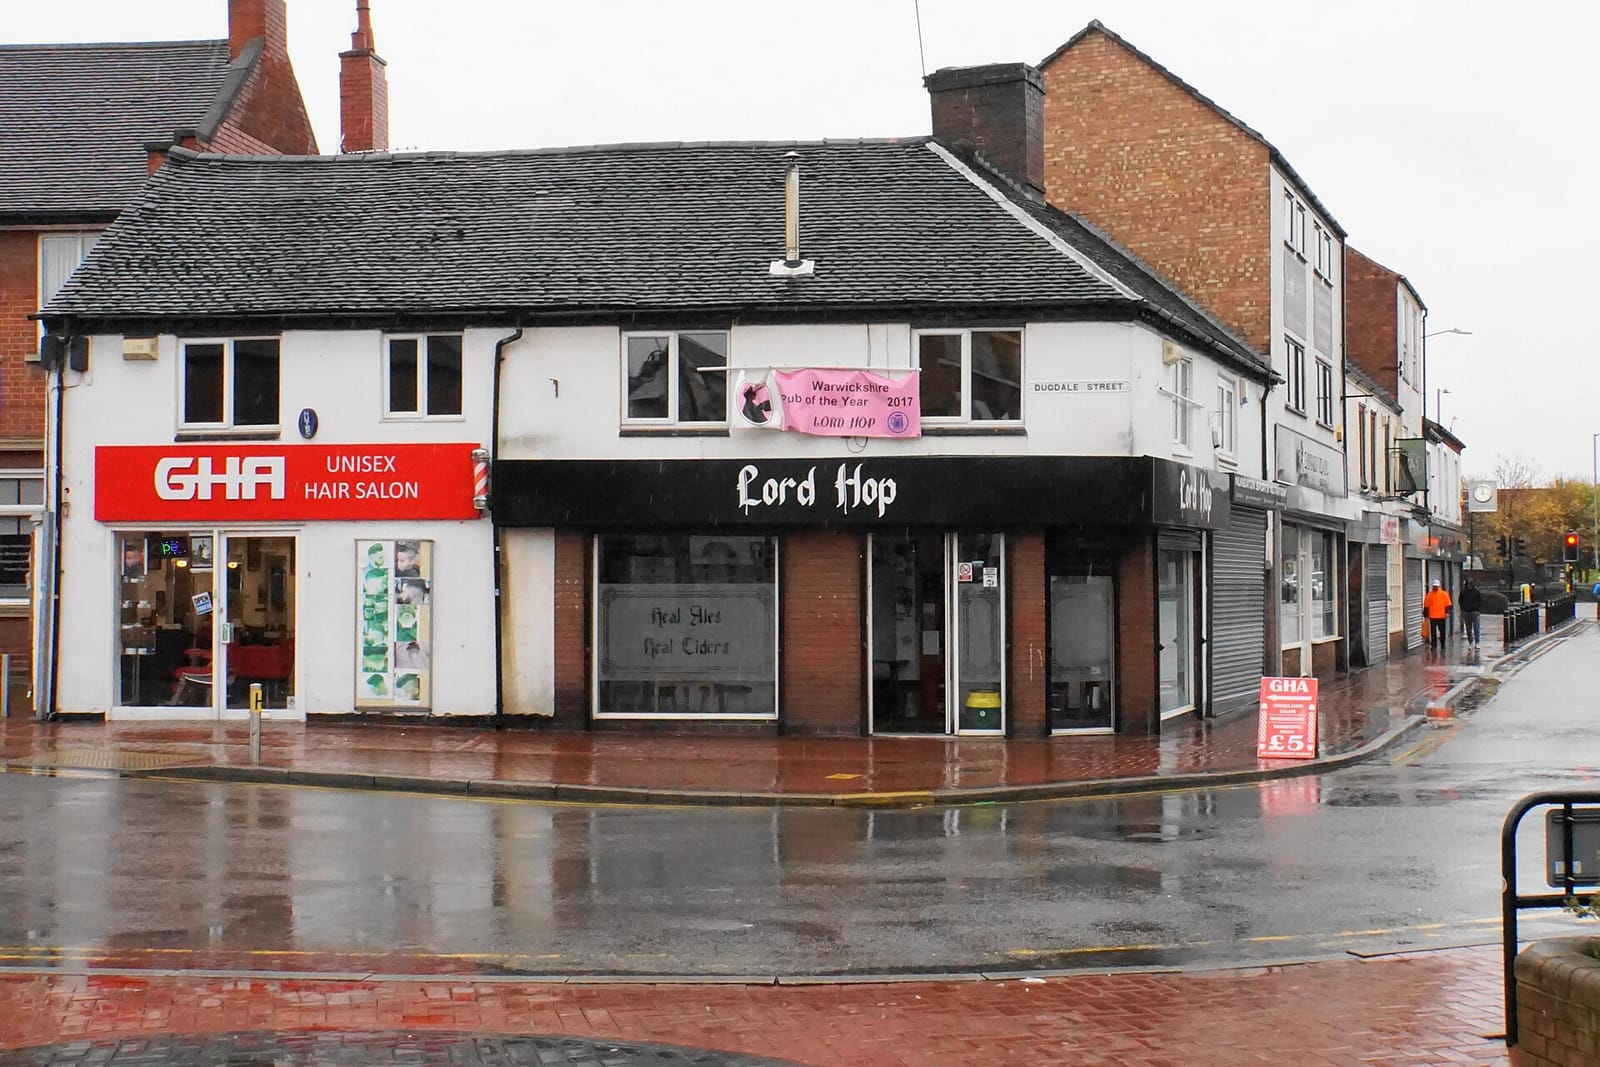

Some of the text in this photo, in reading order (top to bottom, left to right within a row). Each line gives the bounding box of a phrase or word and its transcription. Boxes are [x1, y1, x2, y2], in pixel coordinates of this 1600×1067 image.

[811, 381, 889, 393] Warwickshire
[1034, 382, 1123, 391] DUGDALE STREET
[805, 395, 816, 405] of
[819, 396, 838, 406] the
[841, 396, 869, 407] Year
[887, 397, 913, 407] 2017
[813, 416, 876, 429] LORD HOP
[326, 455, 396, 473] UNISEX
[154, 456, 285, 500] GHA
[304, 481, 418, 499] HAIR SALON
[736, 462, 897, 518] Lord Hop
[1180, 469, 1212, 523] Lord Hop
[651, 605, 721, 628] Real Ales
[644, 638, 672, 659] Real
[1269, 680, 1309, 693] GHA
[1268, 735, 1304, 751] £5
